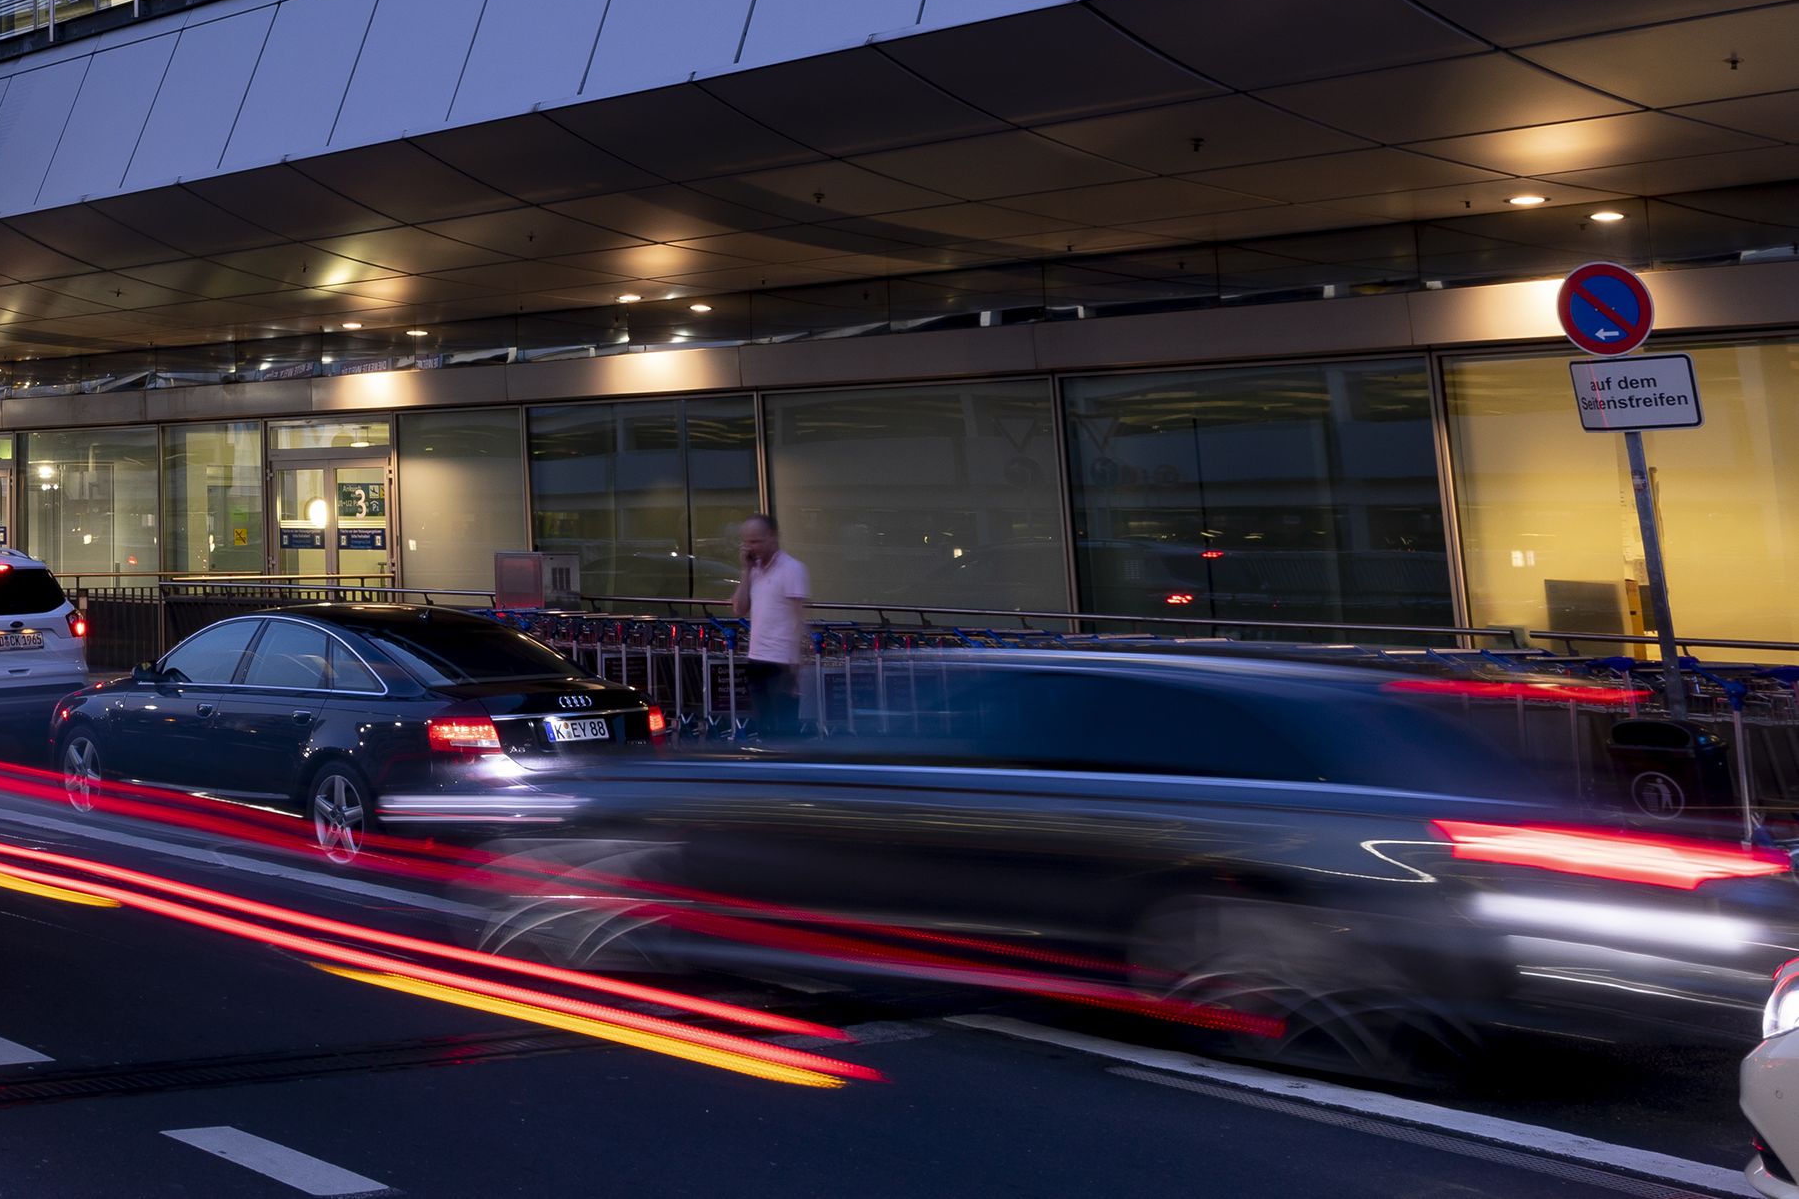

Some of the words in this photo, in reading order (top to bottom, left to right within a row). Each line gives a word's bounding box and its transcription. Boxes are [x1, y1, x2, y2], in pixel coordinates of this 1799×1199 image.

[1590, 377, 1613, 392] auf
[1618, 375, 1658, 390] dem
[1581, 393, 1689, 411] Seitenstreifen
[355, 489, 367, 519] 3
[554, 724, 565, 739] K
[571, 721, 588, 738] EY
[591, 720, 606, 737] 88
